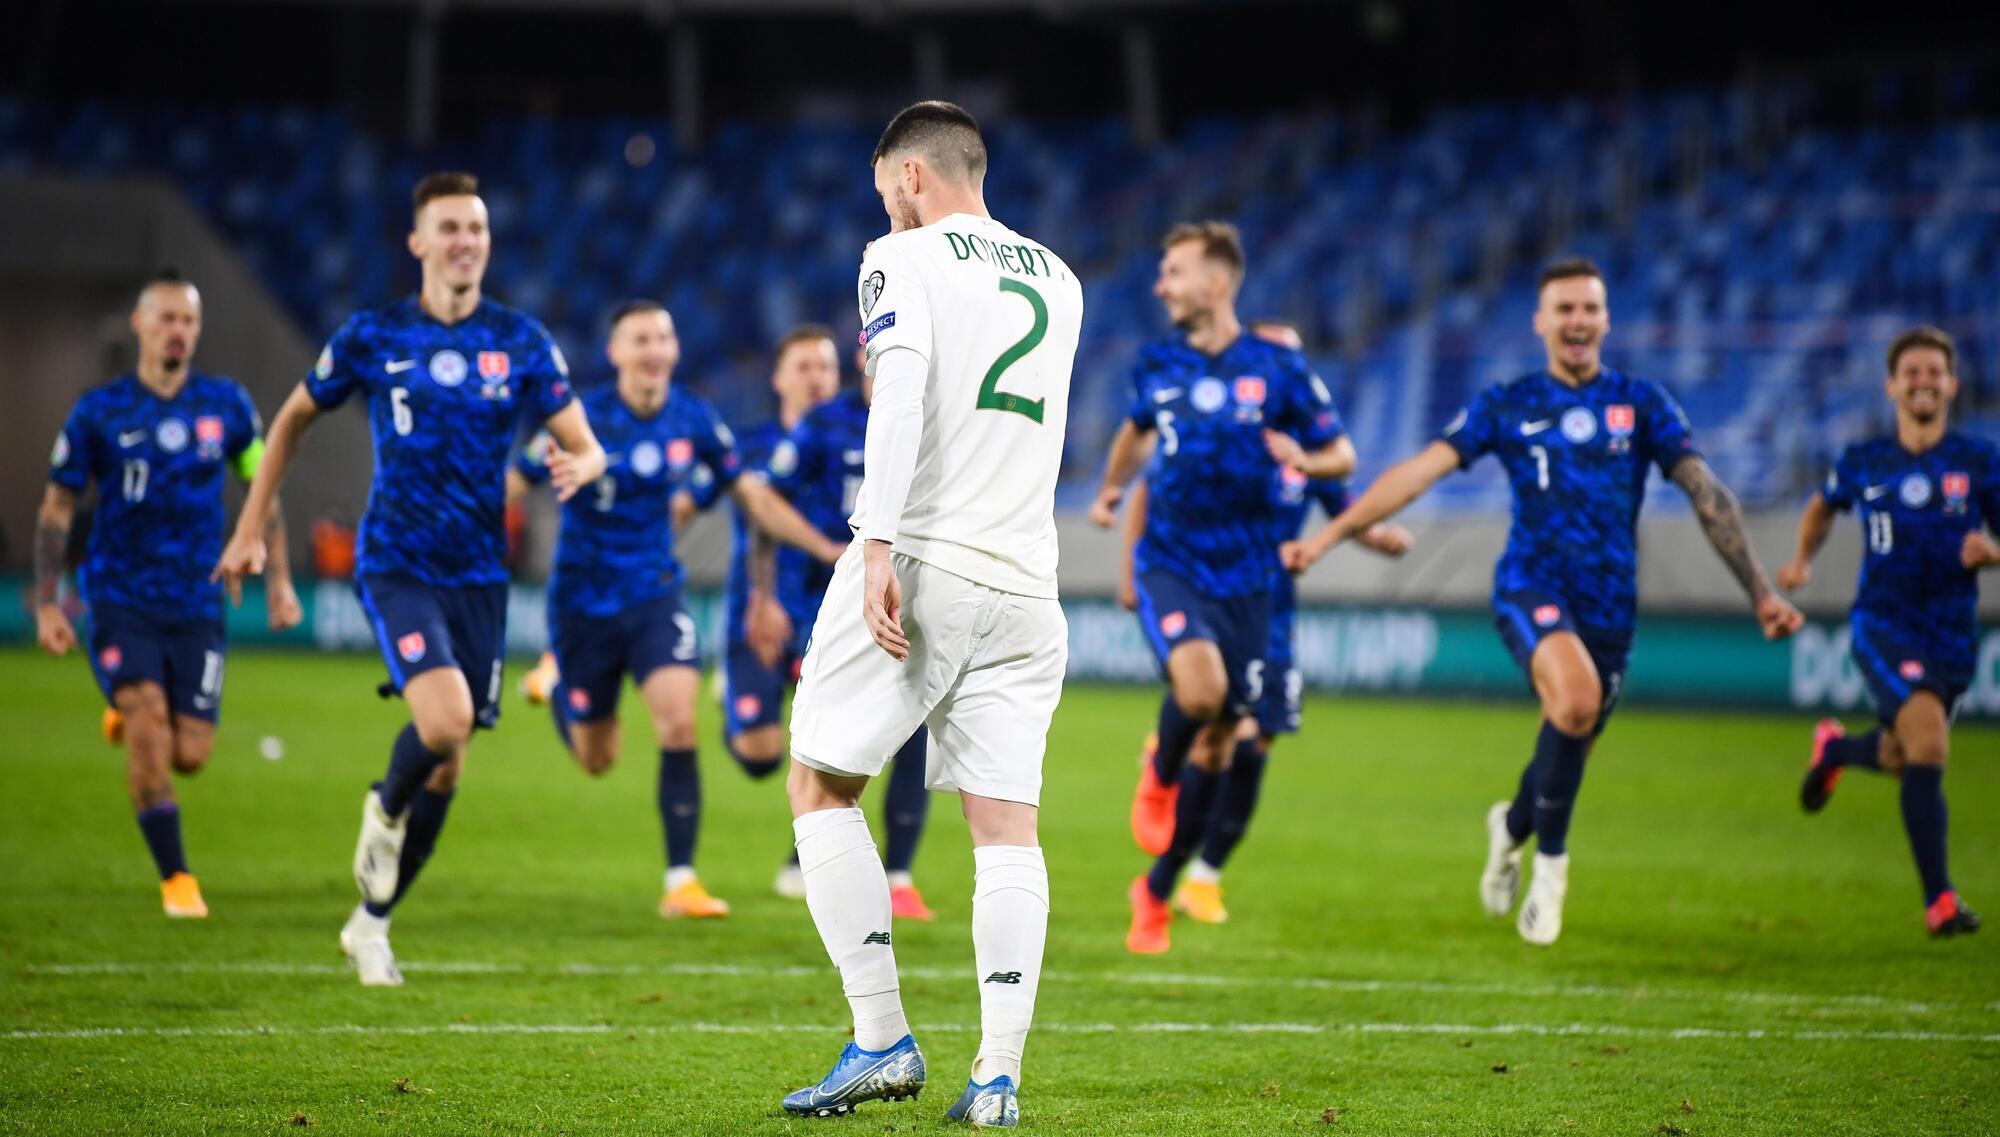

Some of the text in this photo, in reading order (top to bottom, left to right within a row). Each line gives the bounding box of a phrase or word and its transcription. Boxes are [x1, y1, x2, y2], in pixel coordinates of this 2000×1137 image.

[943, 232, 1065, 281] DOHERT
[867, 316, 895, 337] RESPECT
[976, 276, 1048, 425] 2
[390, 387, 413, 436] 6
[1156, 409, 1179, 456] 5
[1529, 445, 1549, 491] 7
[1246, 659, 1264, 702] 5
